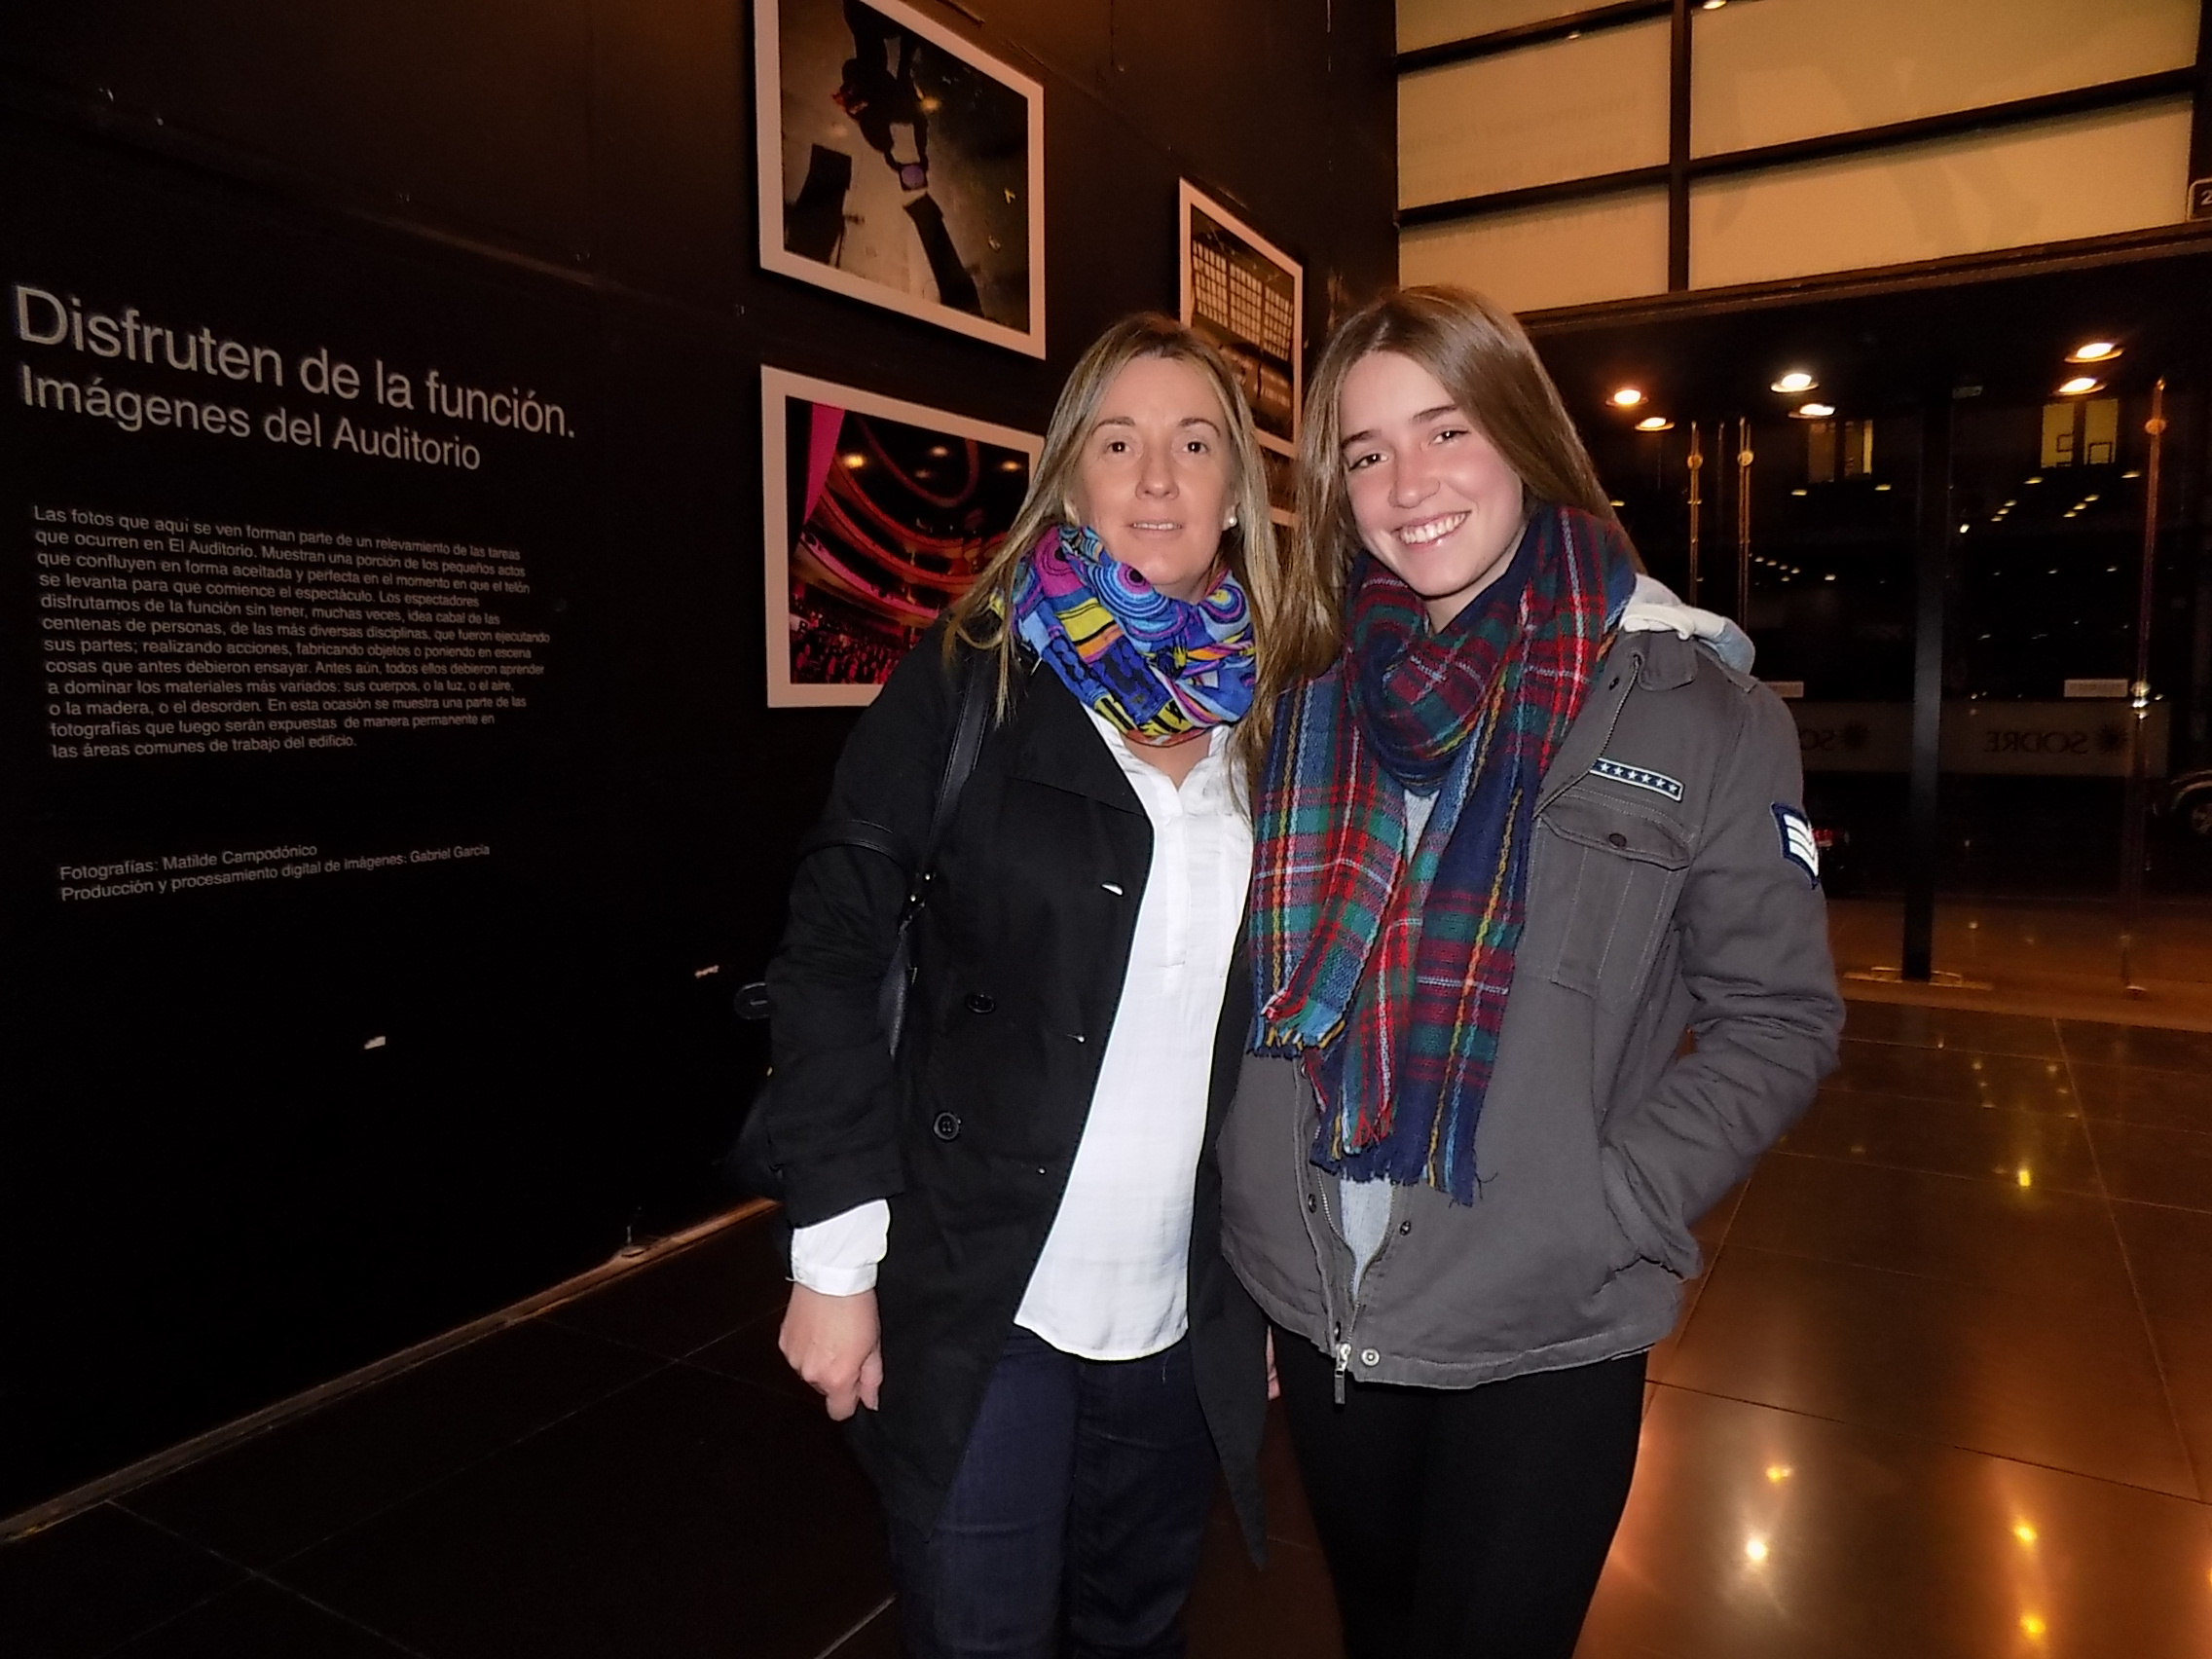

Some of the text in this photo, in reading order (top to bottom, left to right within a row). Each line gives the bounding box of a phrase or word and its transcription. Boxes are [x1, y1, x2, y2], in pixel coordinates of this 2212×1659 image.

[16, 285, 574, 437] Disfruten de la función.
[22, 365, 480, 469] Imágenes del Auditorio
[34, 505, 66, 522] Las
[69, 509, 114, 527] fotos
[119, 516, 149, 531] que
[193, 523, 211, 535] se
[215, 525, 242, 536] ven
[245, 525, 295, 541] forman
[299, 532, 333, 545] parte
[336, 534, 352, 546] de
[356, 537, 373, 547] un
[376, 537, 450, 555] relevamiento
[453, 544, 467, 556] de
[469, 544, 486, 557] las
[488, 547, 521, 560] tareas
[35, 531, 69, 546] que
[75, 534, 138, 549] ocurren
[143, 539, 164, 550] en
[168, 537, 184, 552] El
[188, 539, 257, 558] Auditorio.
[261, 545, 325, 562] Muestran
[328, 553, 352, 565] una
[404, 557, 419, 570] de
[422, 558, 439, 571] los
[498, 565, 526, 577] actos
[37, 553, 71, 568] que
[75, 554, 156, 572] confluyen
[159, 561, 181, 572] en
[185, 560, 229, 575] forma
[233, 565, 292, 579] aceitada
[295, 570, 304, 583] y
[307, 569, 360, 583] perfecta
[362, 573, 379, 584] en
[382, 572, 393, 585] el
[395, 575, 450, 589] momento
[453, 579, 467, 589] en
[469, 580, 490, 593] que
[492, 581, 502, 592] el
[39, 574, 60, 586] se
[65, 573, 128, 590] levanta
[132, 579, 168, 593] para
[172, 582, 202, 596] que
[205, 583, 276, 597] comience
[278, 585, 291, 598] el
[379, 590, 401, 604] Los
[404, 594, 480, 608] espectadores
[41, 593, 140, 611] disfrutamos
[143, 598, 165, 612] de
[168, 599, 184, 612] la
[187, 600, 241, 614] función
[245, 603, 266, 615] sin
[312, 607, 362, 619] muchas
[407, 609, 432, 622] idea
[435, 611, 465, 623] cabal
[467, 612, 482, 624] de
[484, 612, 500, 625] las
[42, 617, 122, 631] centenas
[125, 618, 146, 632] de
[230, 621, 249, 635] de
[252, 622, 274, 636] las
[309, 624, 363, 638] diversas
[433, 630, 456, 643] que
[458, 629, 493, 641] fueron
[44, 640, 75, 651] sus
[142, 639, 222, 653] realizando
[296, 642, 364, 655] fabricando
[367, 644, 411, 659] objetos
[414, 646, 422, 656] o
[424, 645, 475, 659] poniendo
[477, 648, 492, 658] en
[494, 648, 532, 658] escena
[46, 661, 97, 673] cosas
[101, 661, 132, 676] que
[138, 660, 181, 673] antes
[185, 660, 250, 674] debieron
[315, 661, 351, 674] Antes
[385, 662, 418, 674] todos
[421, 662, 448, 674] ellos
[450, 662, 498, 675] debieron
[499, 664, 544, 677] aprender
[47, 682, 59, 694] a
[64, 680, 132, 694] dominar
[137, 680, 161, 693] los
[165, 680, 242, 693] materiales
[344, 682, 366, 692] sus
[423, 682, 431, 691] o
[433, 680, 444, 691] la
[468, 682, 476, 691] o
[478, 680, 489, 691] el
[49, 704, 60, 716] o
[66, 701, 82, 715] la
[86, 700, 154, 716] madera,
[159, 703, 168, 714] o
[172, 700, 187, 713] el
[268, 698, 286, 711] En
[289, 699, 319, 711] esta
[374, 699, 389, 710] se
[392, 697, 439, 709] muestra
[442, 698, 462, 708] una
[465, 697, 493, 710] parte
[496, 696, 509, 708] de
[511, 696, 527, 707] las
[145, 723, 174, 737] que
[179, 720, 220, 736] luego
[224, 719, 265, 732] serán
[268, 718, 337, 733] expuestas
[344, 717, 359, 728] de
[363, 717, 410, 727] manera
[412, 714, 478, 729] permanente
[481, 715, 495, 724] en
[52, 745, 78, 757] las
[134, 742, 205, 756] comunes
[208, 739, 228, 752] de
[232, 737, 280, 753] trabajo
[283, 736, 305, 749] del
[163, 854, 217, 869] Matilde
[222, 845, 317, 864] Campodónico
[61, 880, 154, 901] Producción
[158, 880, 166, 894] y
[171, 867, 277, 892] procesamiento
[281, 861, 321, 878] digital
[324, 860, 340, 872] de
[410, 848, 451, 863] Gabriel
